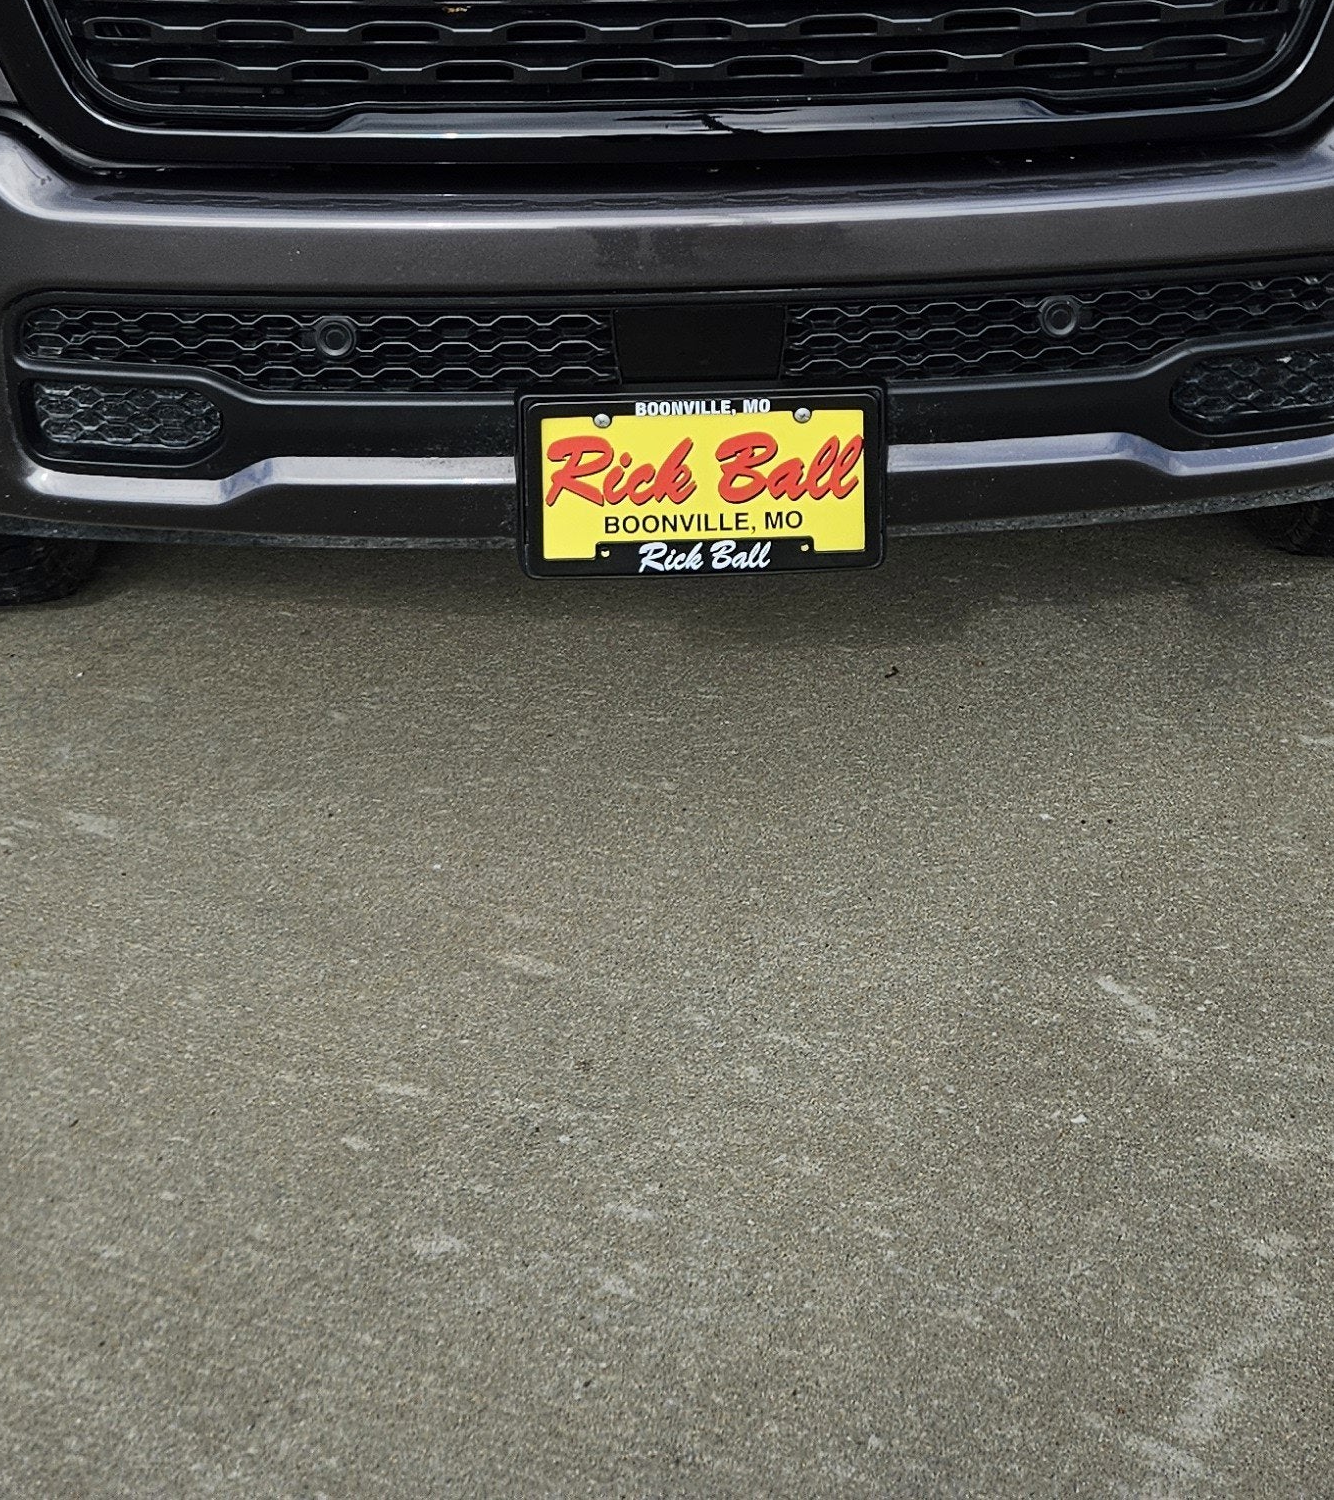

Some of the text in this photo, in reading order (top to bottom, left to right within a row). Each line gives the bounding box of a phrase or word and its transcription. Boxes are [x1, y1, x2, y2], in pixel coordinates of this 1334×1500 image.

[635, 398, 771, 417] BOONVILLE, MO
[545, 431, 865, 506] Rick Ball
[604, 510, 804, 534] BOONVILLE, MO
[638, 541, 771, 573] Rick Ball
